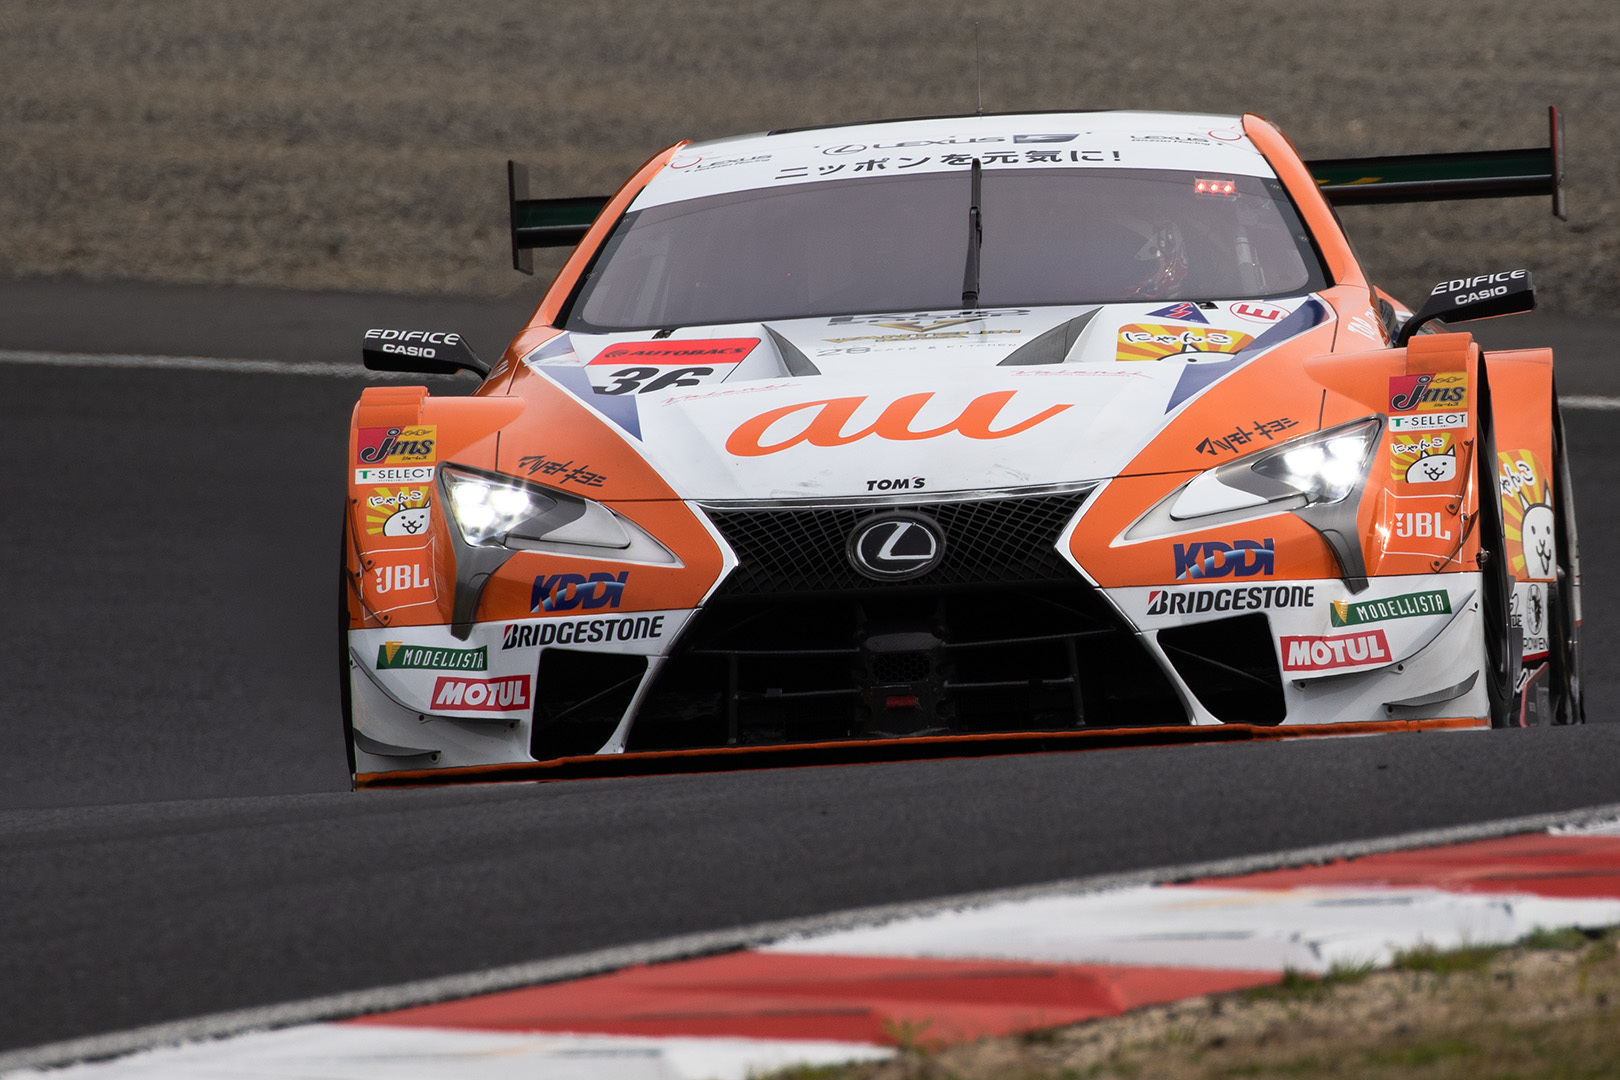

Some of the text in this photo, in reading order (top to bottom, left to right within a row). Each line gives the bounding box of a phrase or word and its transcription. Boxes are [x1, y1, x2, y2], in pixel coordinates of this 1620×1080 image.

[873, 136, 1005, 149] LEXUS
[1431, 269, 1526, 296] EDIFICE
[1455, 285, 1508, 306] CASIO
[364, 328, 461, 346] EDIFICE
[382, 343, 436, 359] CASIO
[1125, 332, 1231, 345] にゃんこ
[629, 348, 747, 357] AUTOBACS
[592, 366, 714, 395] 36
[1391, 375, 1467, 412] jms
[1392, 413, 1466, 428] T-SELECT
[359, 428, 436, 464] jms
[1195, 417, 1300, 456] マツモトキヨシ
[1392, 438, 1445, 453] にゃんこ
[358, 468, 433, 480] T-SELECT
[518, 455, 607, 488] マツモトキヨシ
[867, 476, 926, 491] TOM'S
[369, 491, 423, 507] にゃんこ
[1395, 512, 1451, 541] JBL
[1173, 538, 1275, 580] KDDI
[375, 564, 430, 594] JBL
[530, 571, 629, 614] KDDI
[1146, 586, 1315, 616] BRIDGESTONE
[1355, 594, 1445, 622] MODELLISTA
[502, 615, 665, 651] BRIDGESTONE
[402, 648, 484, 669] MODELLISTA
[1287, 634, 1385, 666] MOTUL
[435, 678, 526, 706] MOTUL
